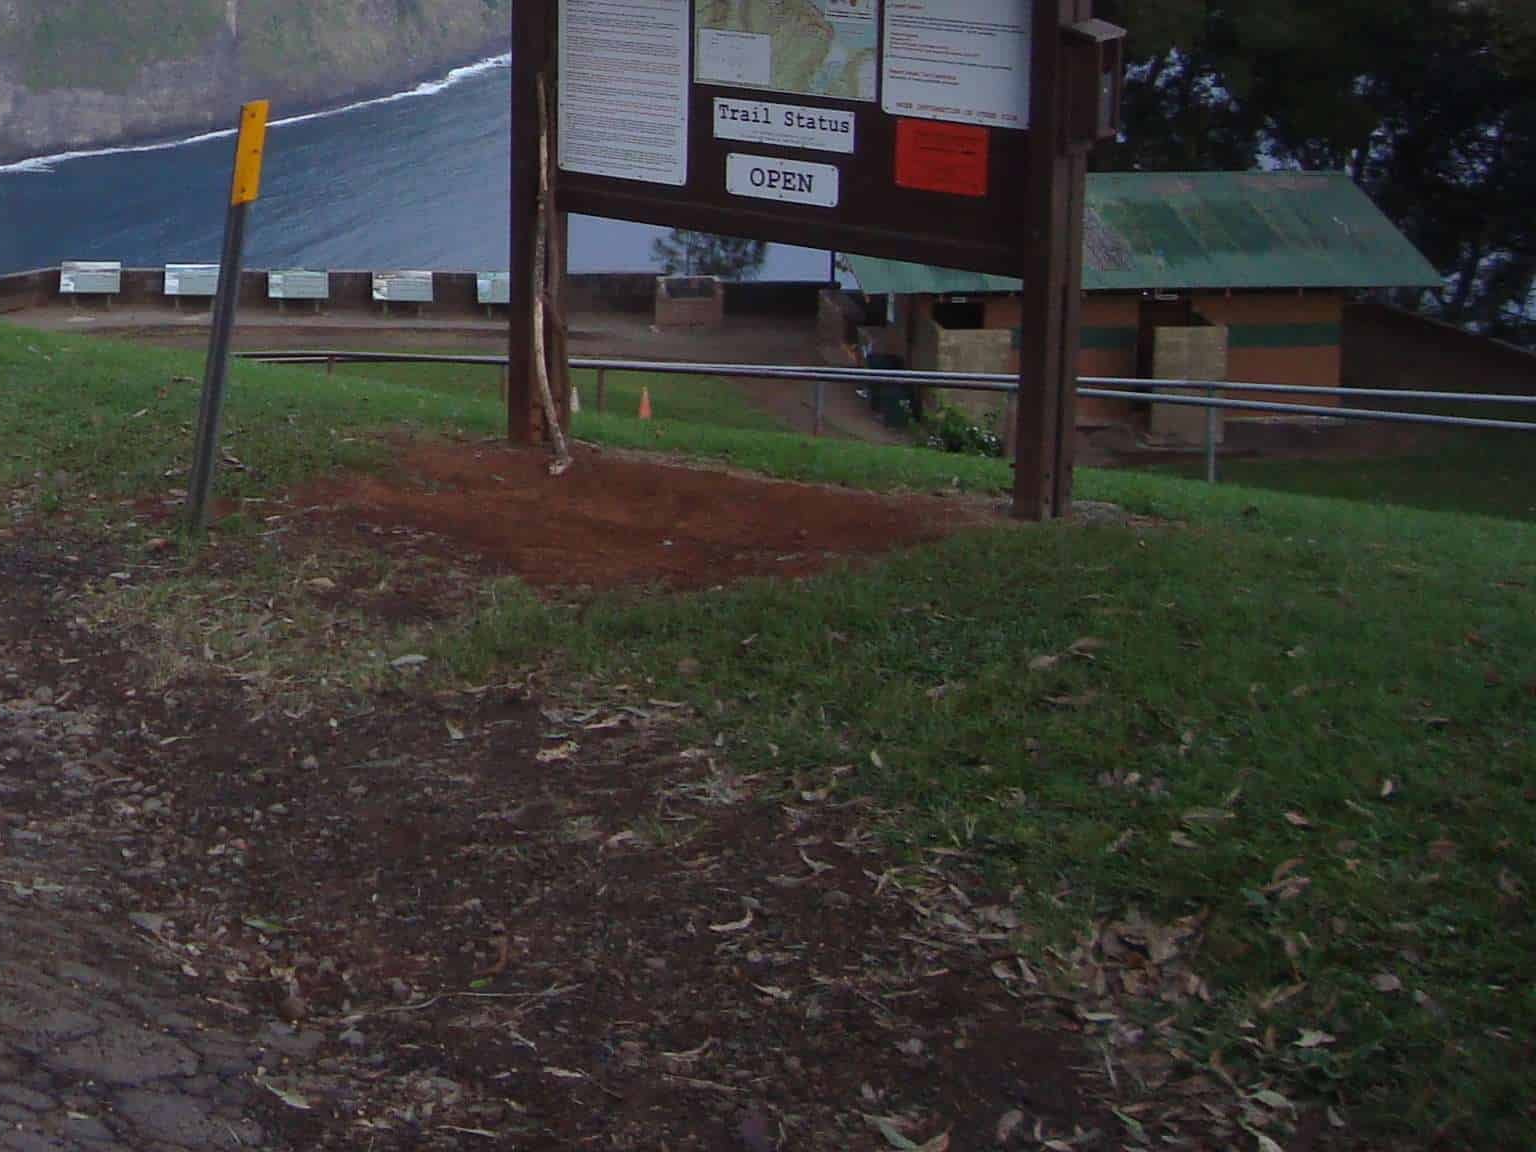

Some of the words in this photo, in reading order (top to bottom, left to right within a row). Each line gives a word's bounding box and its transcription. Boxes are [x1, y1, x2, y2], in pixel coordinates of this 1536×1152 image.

[718, 103, 771, 124] Trail
[783, 111, 850, 133] Status
[749, 167, 814, 193] OPEN
